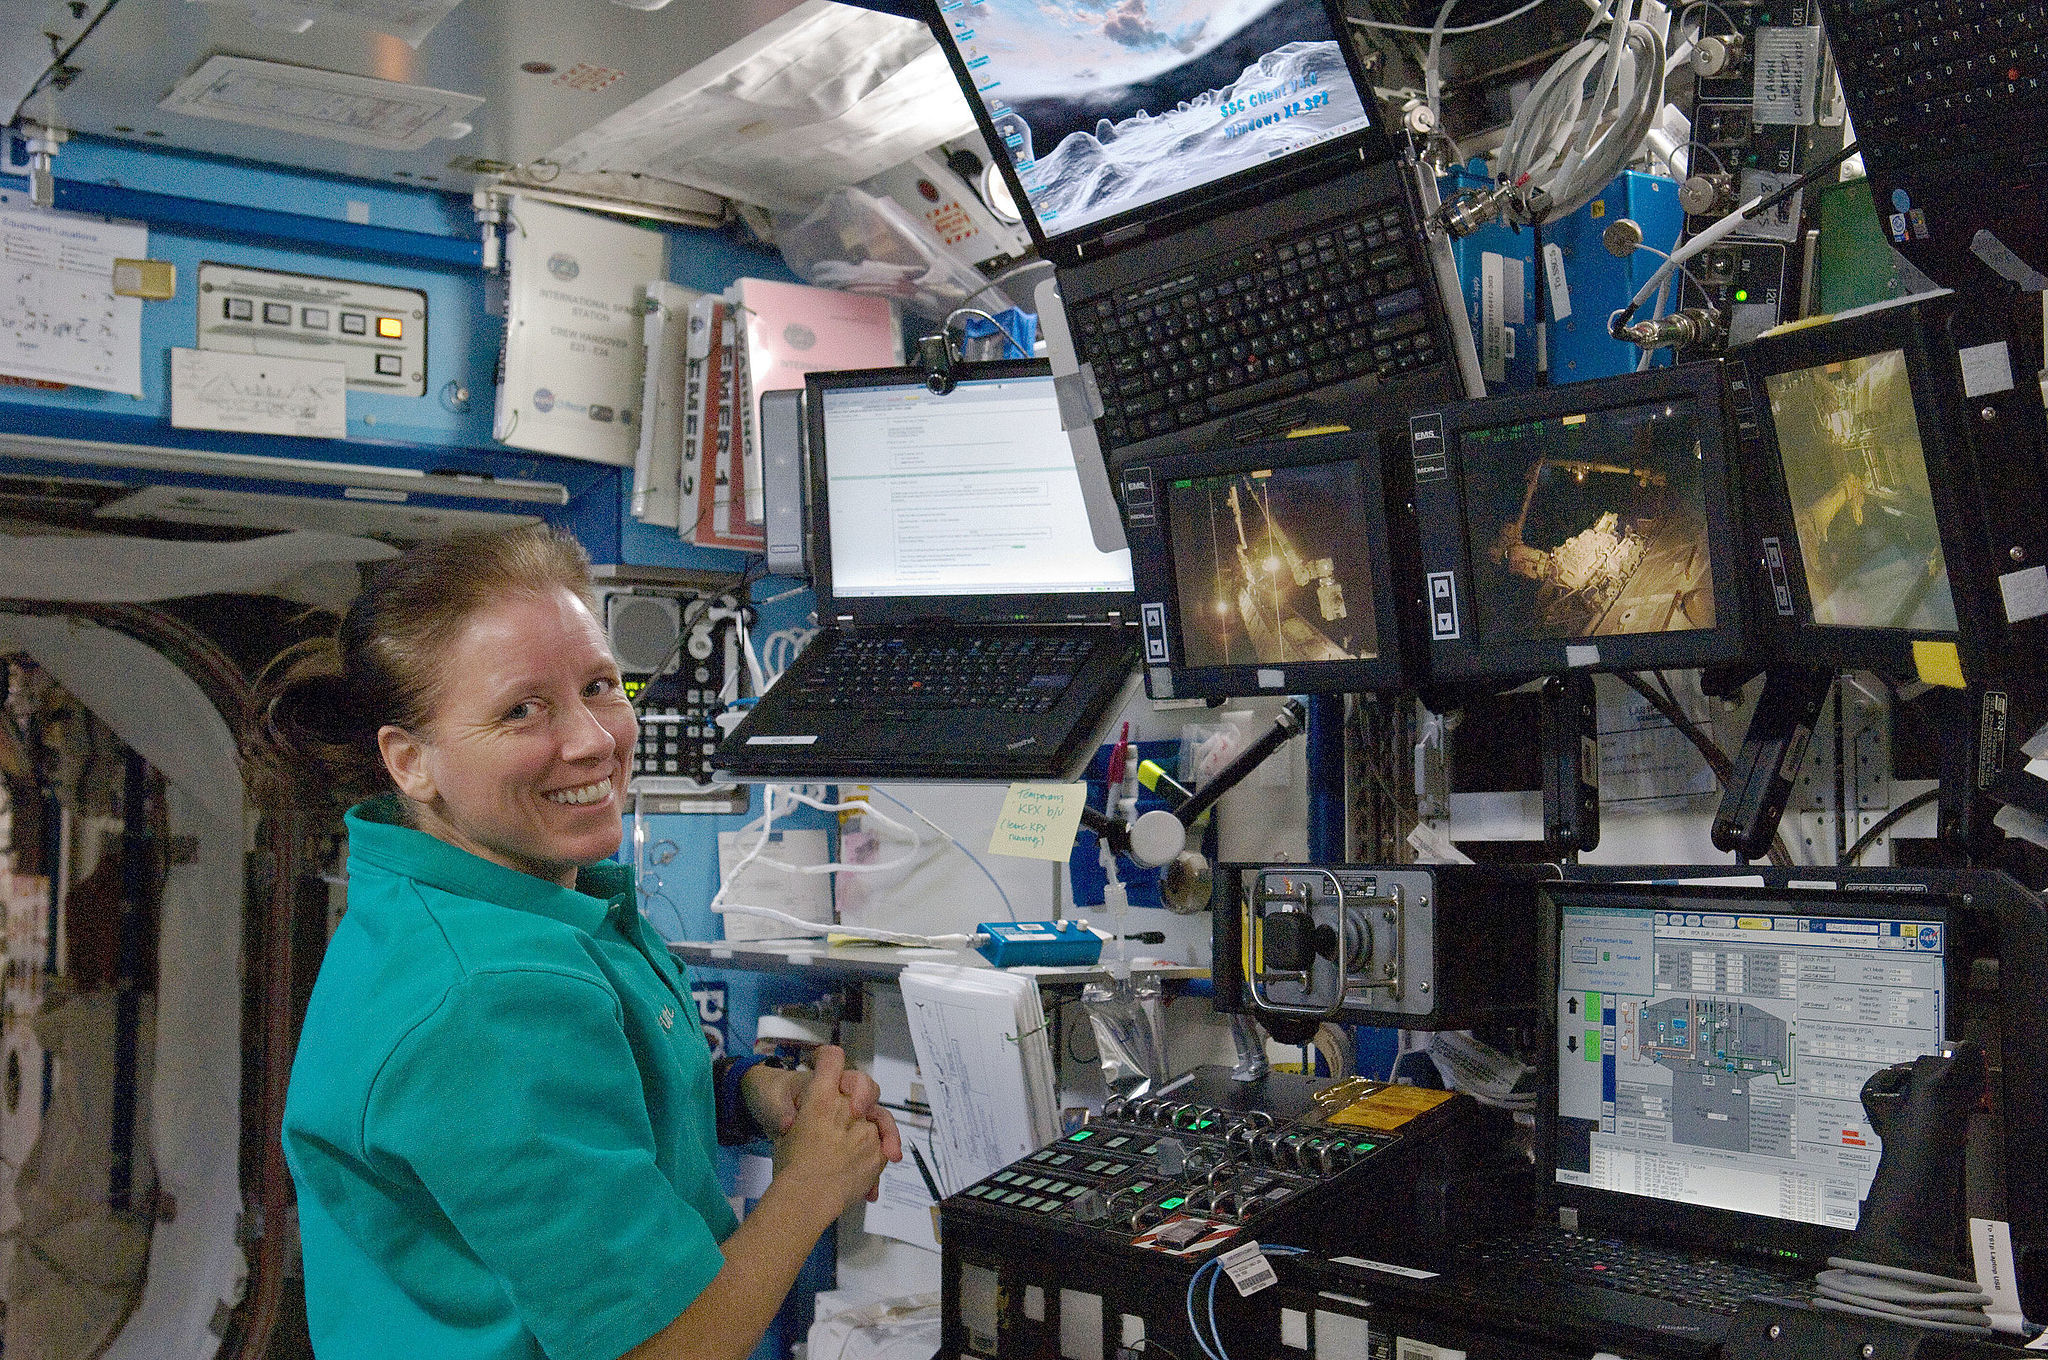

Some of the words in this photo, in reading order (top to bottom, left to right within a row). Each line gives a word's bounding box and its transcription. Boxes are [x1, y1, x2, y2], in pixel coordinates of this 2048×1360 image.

[1219, 98, 1247, 118] SSC
[1249, 83, 1286, 108] Client
[1224, 112, 1282, 140] Windows
[1283, 102, 1302, 118] XP
[1304, 91, 1331, 111] SP2
[682, 356, 702, 463] EMER
[715, 345, 734, 454] EMER
[1414, 430, 1435, 442] EMS
[681, 475, 695, 498] 2
[716, 469, 729, 488] 1
[1990, 1251, 1999, 1275] Laptop
[1993, 1275, 2002, 1291] USB
